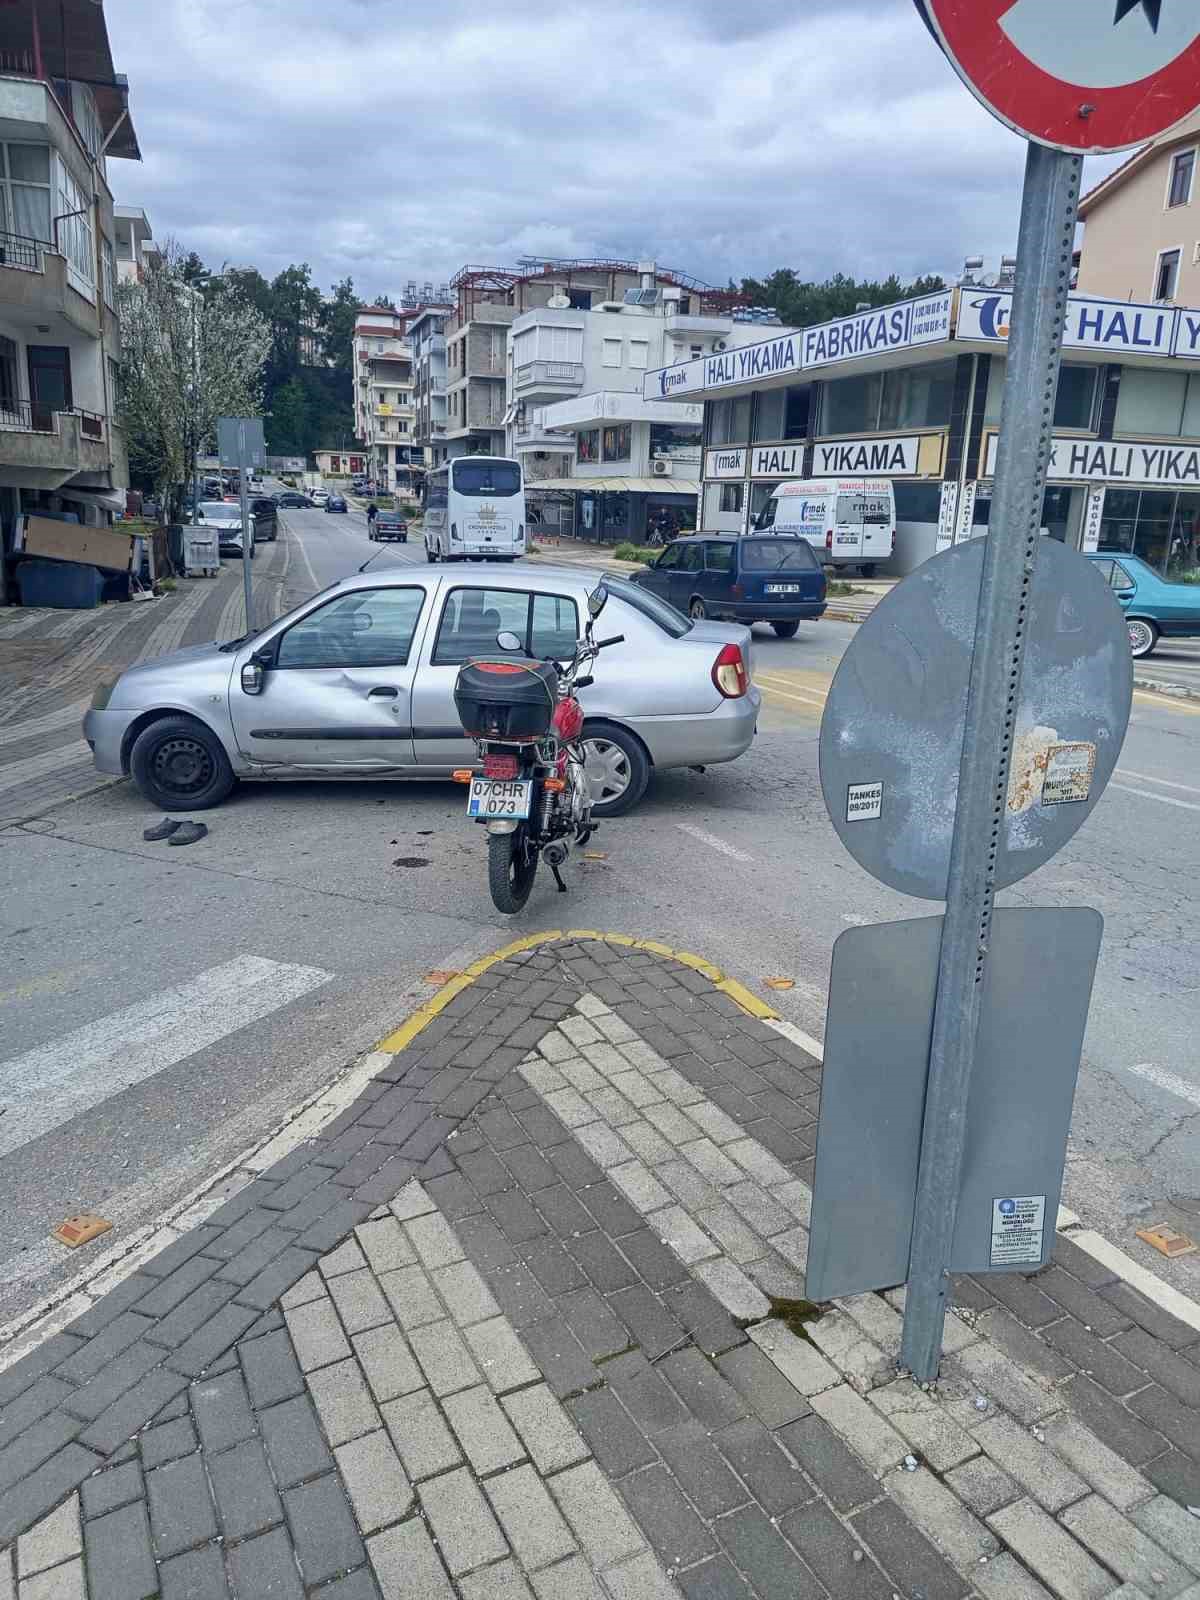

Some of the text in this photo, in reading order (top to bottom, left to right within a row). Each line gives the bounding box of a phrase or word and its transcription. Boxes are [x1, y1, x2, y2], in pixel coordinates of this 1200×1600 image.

[1078, 307, 1165, 347] HALI
[708, 354, 736, 384] HALI
[740, 339, 794, 377] YIKAMA
[757, 451, 797, 473] HALI
[821, 443, 906, 471] YIKAMA
[1069, 444, 1134, 477] HALI
[488, 800, 516, 814] 073
